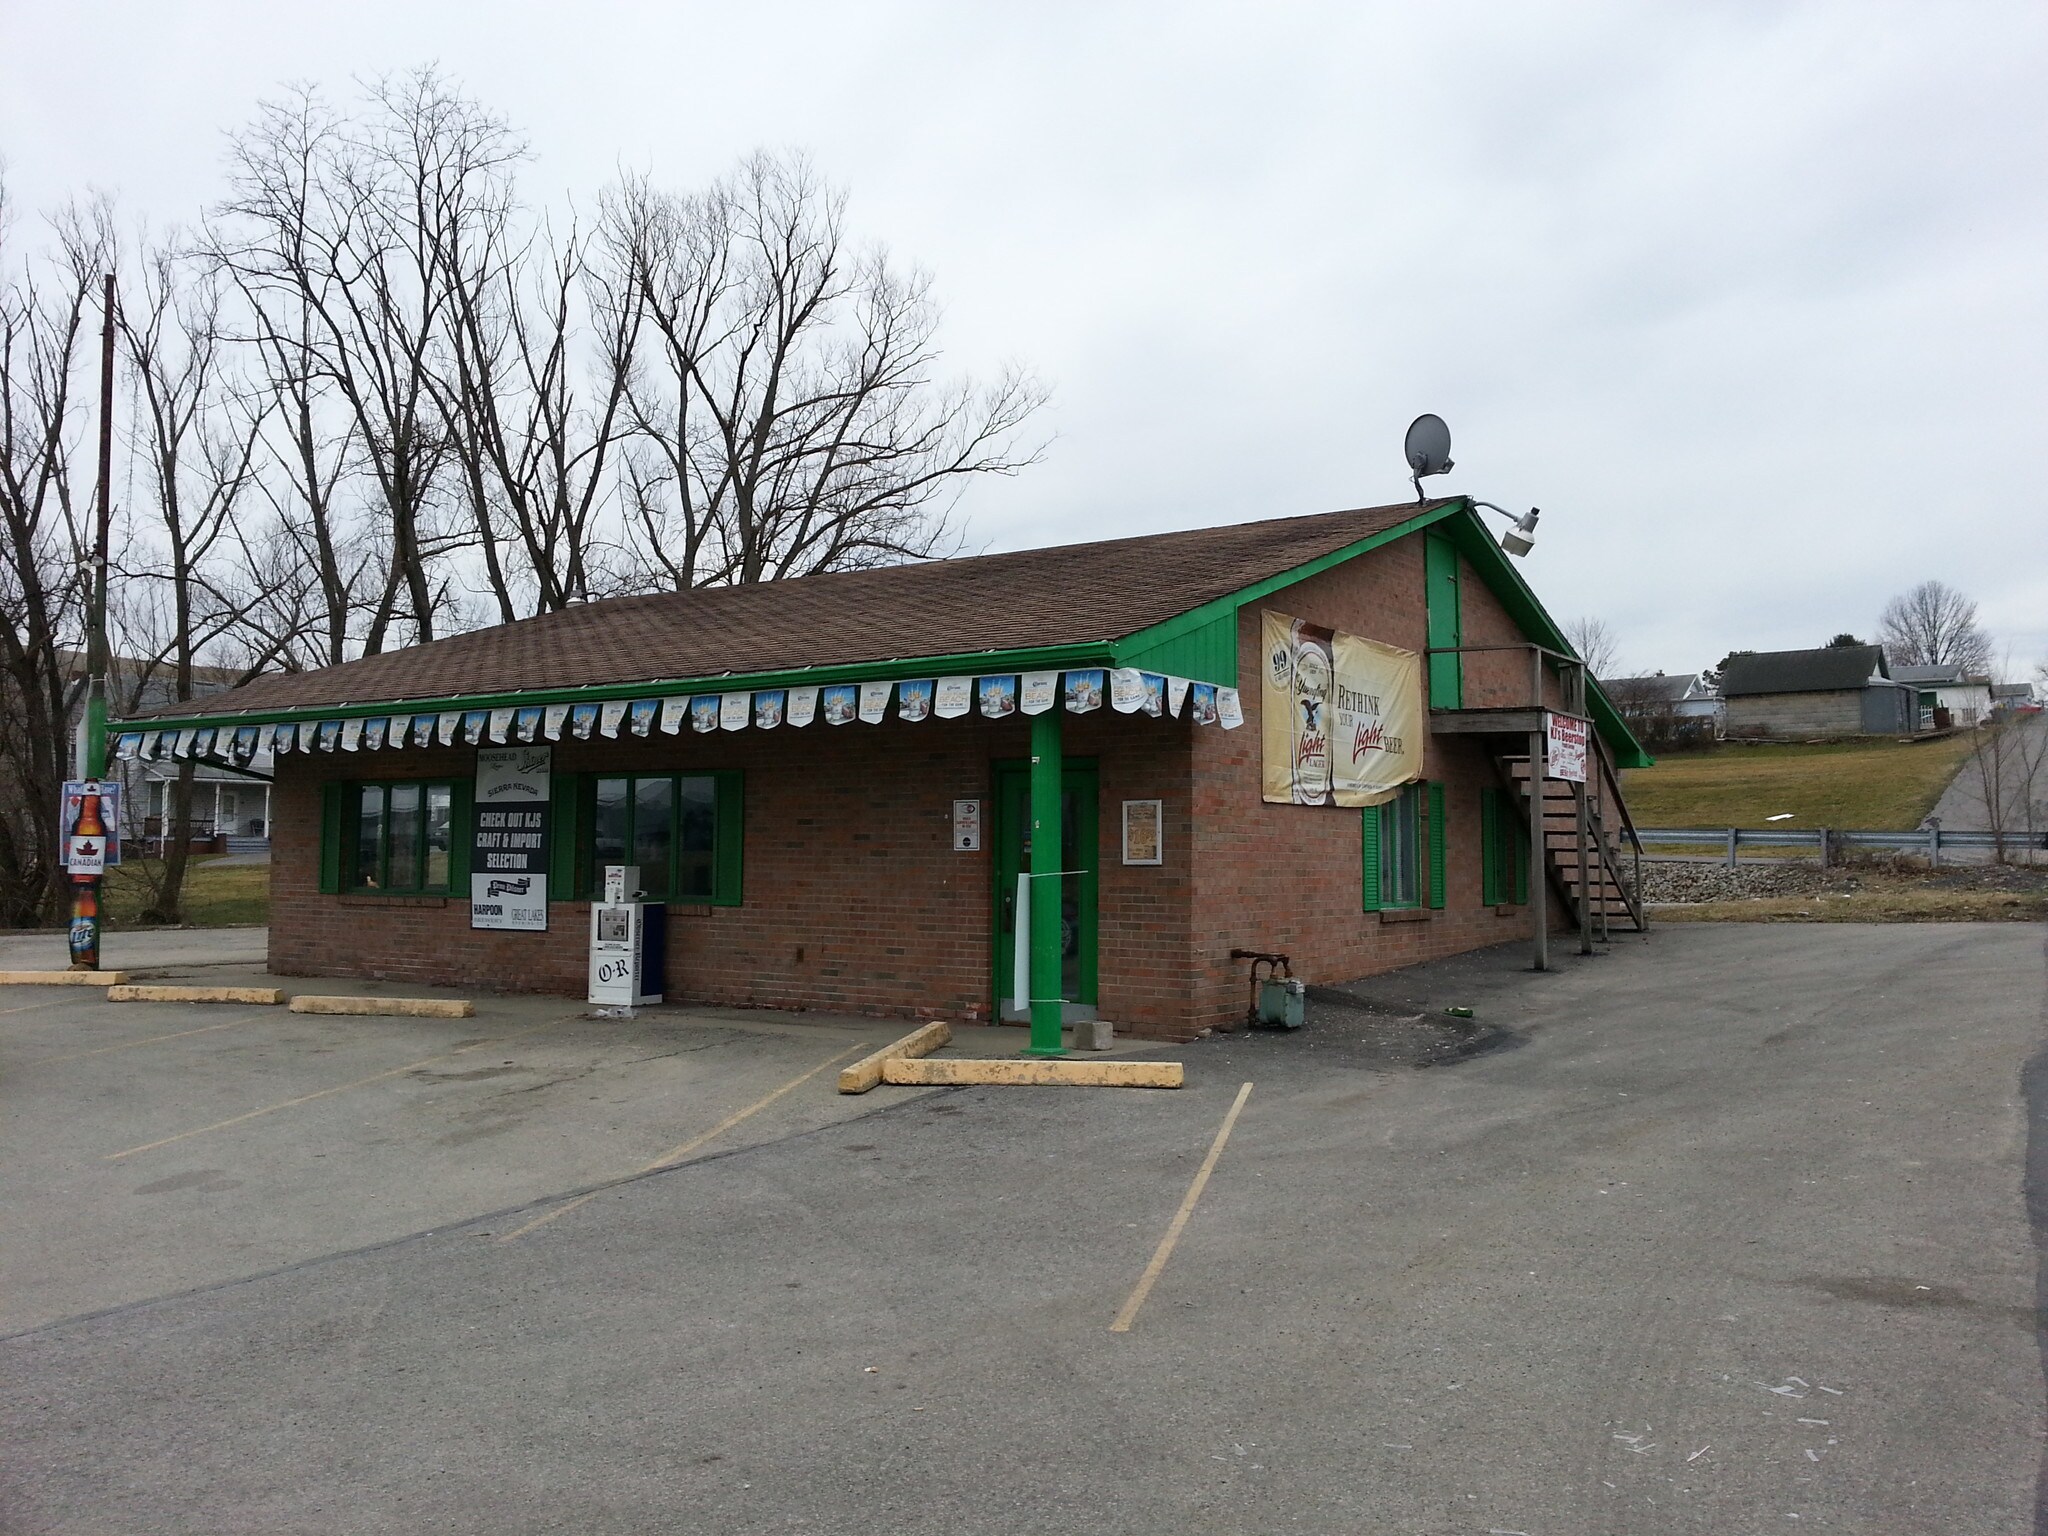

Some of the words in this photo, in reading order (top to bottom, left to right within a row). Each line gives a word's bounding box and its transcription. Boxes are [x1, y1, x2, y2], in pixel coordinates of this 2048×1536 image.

[1273, 650, 1287, 671] 99
[1338, 684, 1380, 716] RETHINK
[1339, 712, 1354, 727] YOUR
[1298, 730, 1326, 769] Light
[1352, 719, 1384, 765] Light
[487, 783, 513, 798] SIERRA
[512, 782, 539, 797] NEVADA
[480, 812, 506, 828] CHECK
[507, 812, 524, 828] OUT
[524, 812, 542, 828] KJS
[476, 832, 502, 848] CRAFT
[502, 832, 510, 848] &
[510, 833, 543, 849] IMPORT
[69, 858, 102, 867] CANADIAN
[486, 853, 528, 869] SELECTION
[473, 904, 503, 916] HARPOON
[511, 909, 528, 921] GREAT
[528, 909, 545, 922] LAKES
